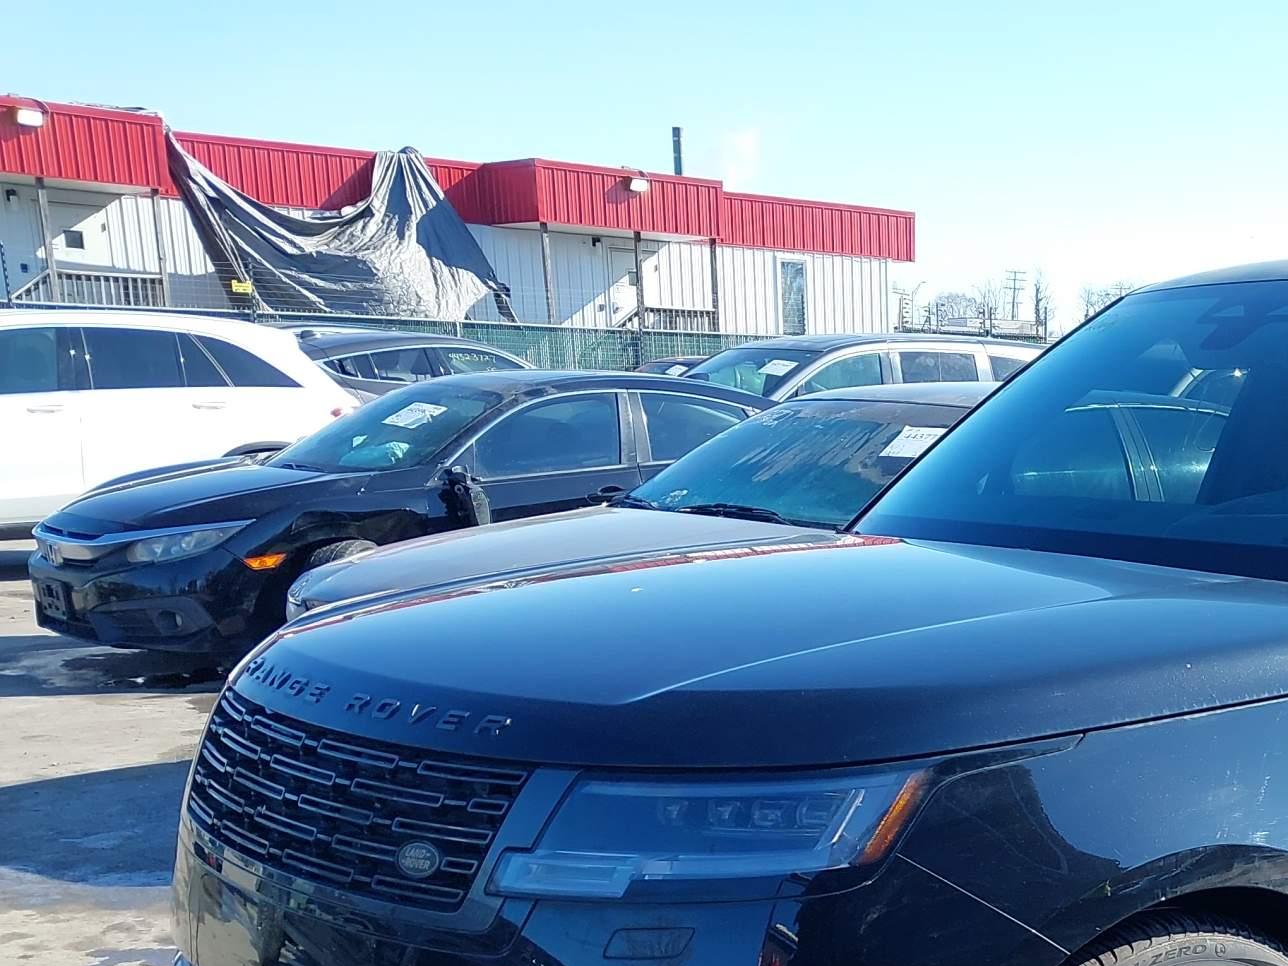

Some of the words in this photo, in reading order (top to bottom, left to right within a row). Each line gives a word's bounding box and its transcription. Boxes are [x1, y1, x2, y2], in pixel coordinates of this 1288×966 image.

[246, 657, 331, 703] RANGE
[344, 692, 512, 736] ROVER
[1150, 944, 1208, 965] ZERO
